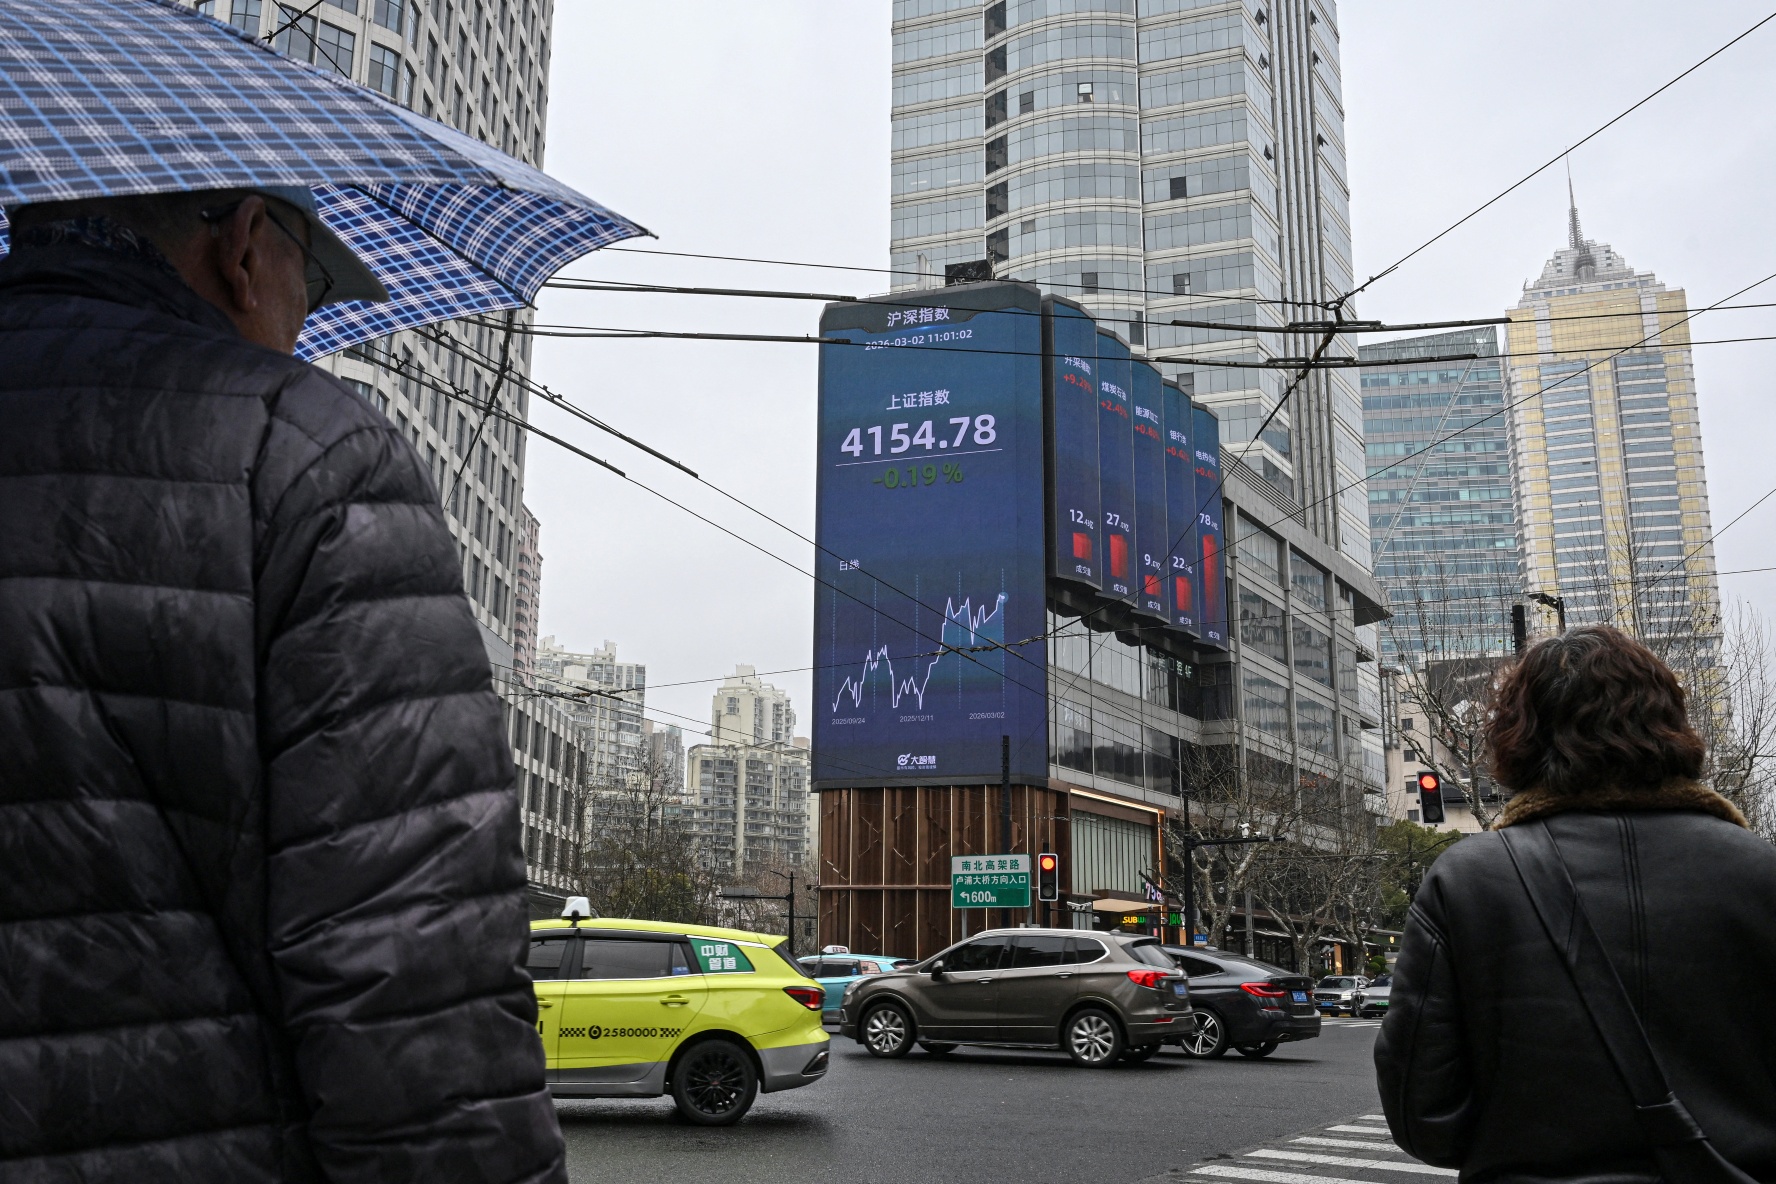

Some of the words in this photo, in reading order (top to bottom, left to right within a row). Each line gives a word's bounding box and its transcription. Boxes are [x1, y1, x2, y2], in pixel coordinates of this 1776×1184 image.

[887, 305, 950, 327] 沪深指数
[865, 335, 925, 351] 2026-03-02
[928, 329, 973, 343] 11:01:02
[886, 389, 950, 410] 上证指数
[841, 414, 996, 457] 4154.78
[839, 559, 860, 571] 日线
[831, 717, 866, 725] 2025/09/24
[900, 714, 934, 722] 2025/12/11
[969, 711, 1005, 720] 2026/03/02
[910, 755, 936, 765] 大智慧
[961, 859, 1020, 872] 南北高架路
[955, 874, 1027, 885] 卢浦大桥方向入口
[971, 890, 997, 903] 600m
[1122, 916, 1147, 924] SUBW
[701, 944, 729, 957] 中财
[709, 957, 737, 971] 管道
[603, 1027, 658, 1038] 2580000
